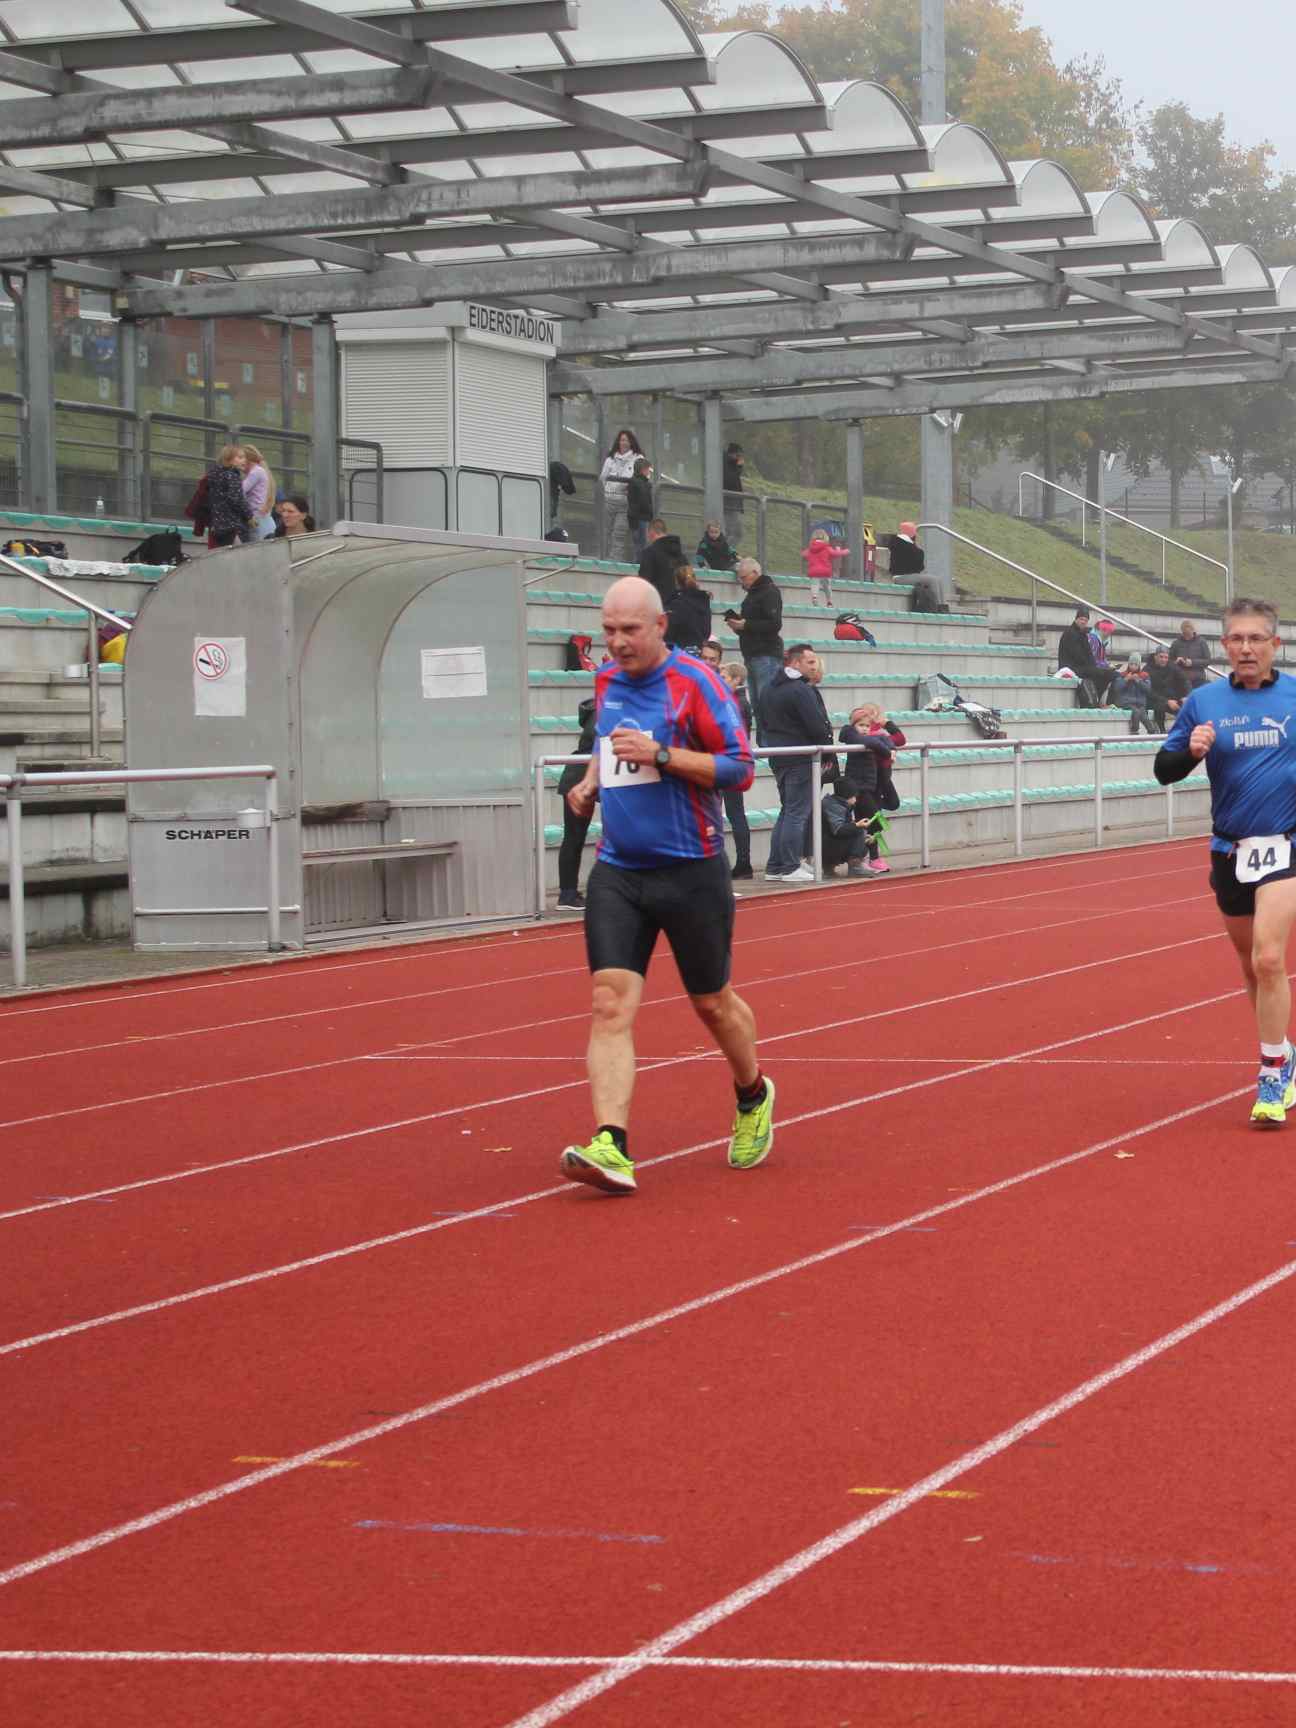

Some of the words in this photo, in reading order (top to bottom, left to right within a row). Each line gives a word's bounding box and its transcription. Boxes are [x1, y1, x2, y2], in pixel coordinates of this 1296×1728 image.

[469, 305, 554, 344] EIDERSTADION
[1234, 730, 1279, 749] PUMA
[1247, 847, 1277, 871] 44
